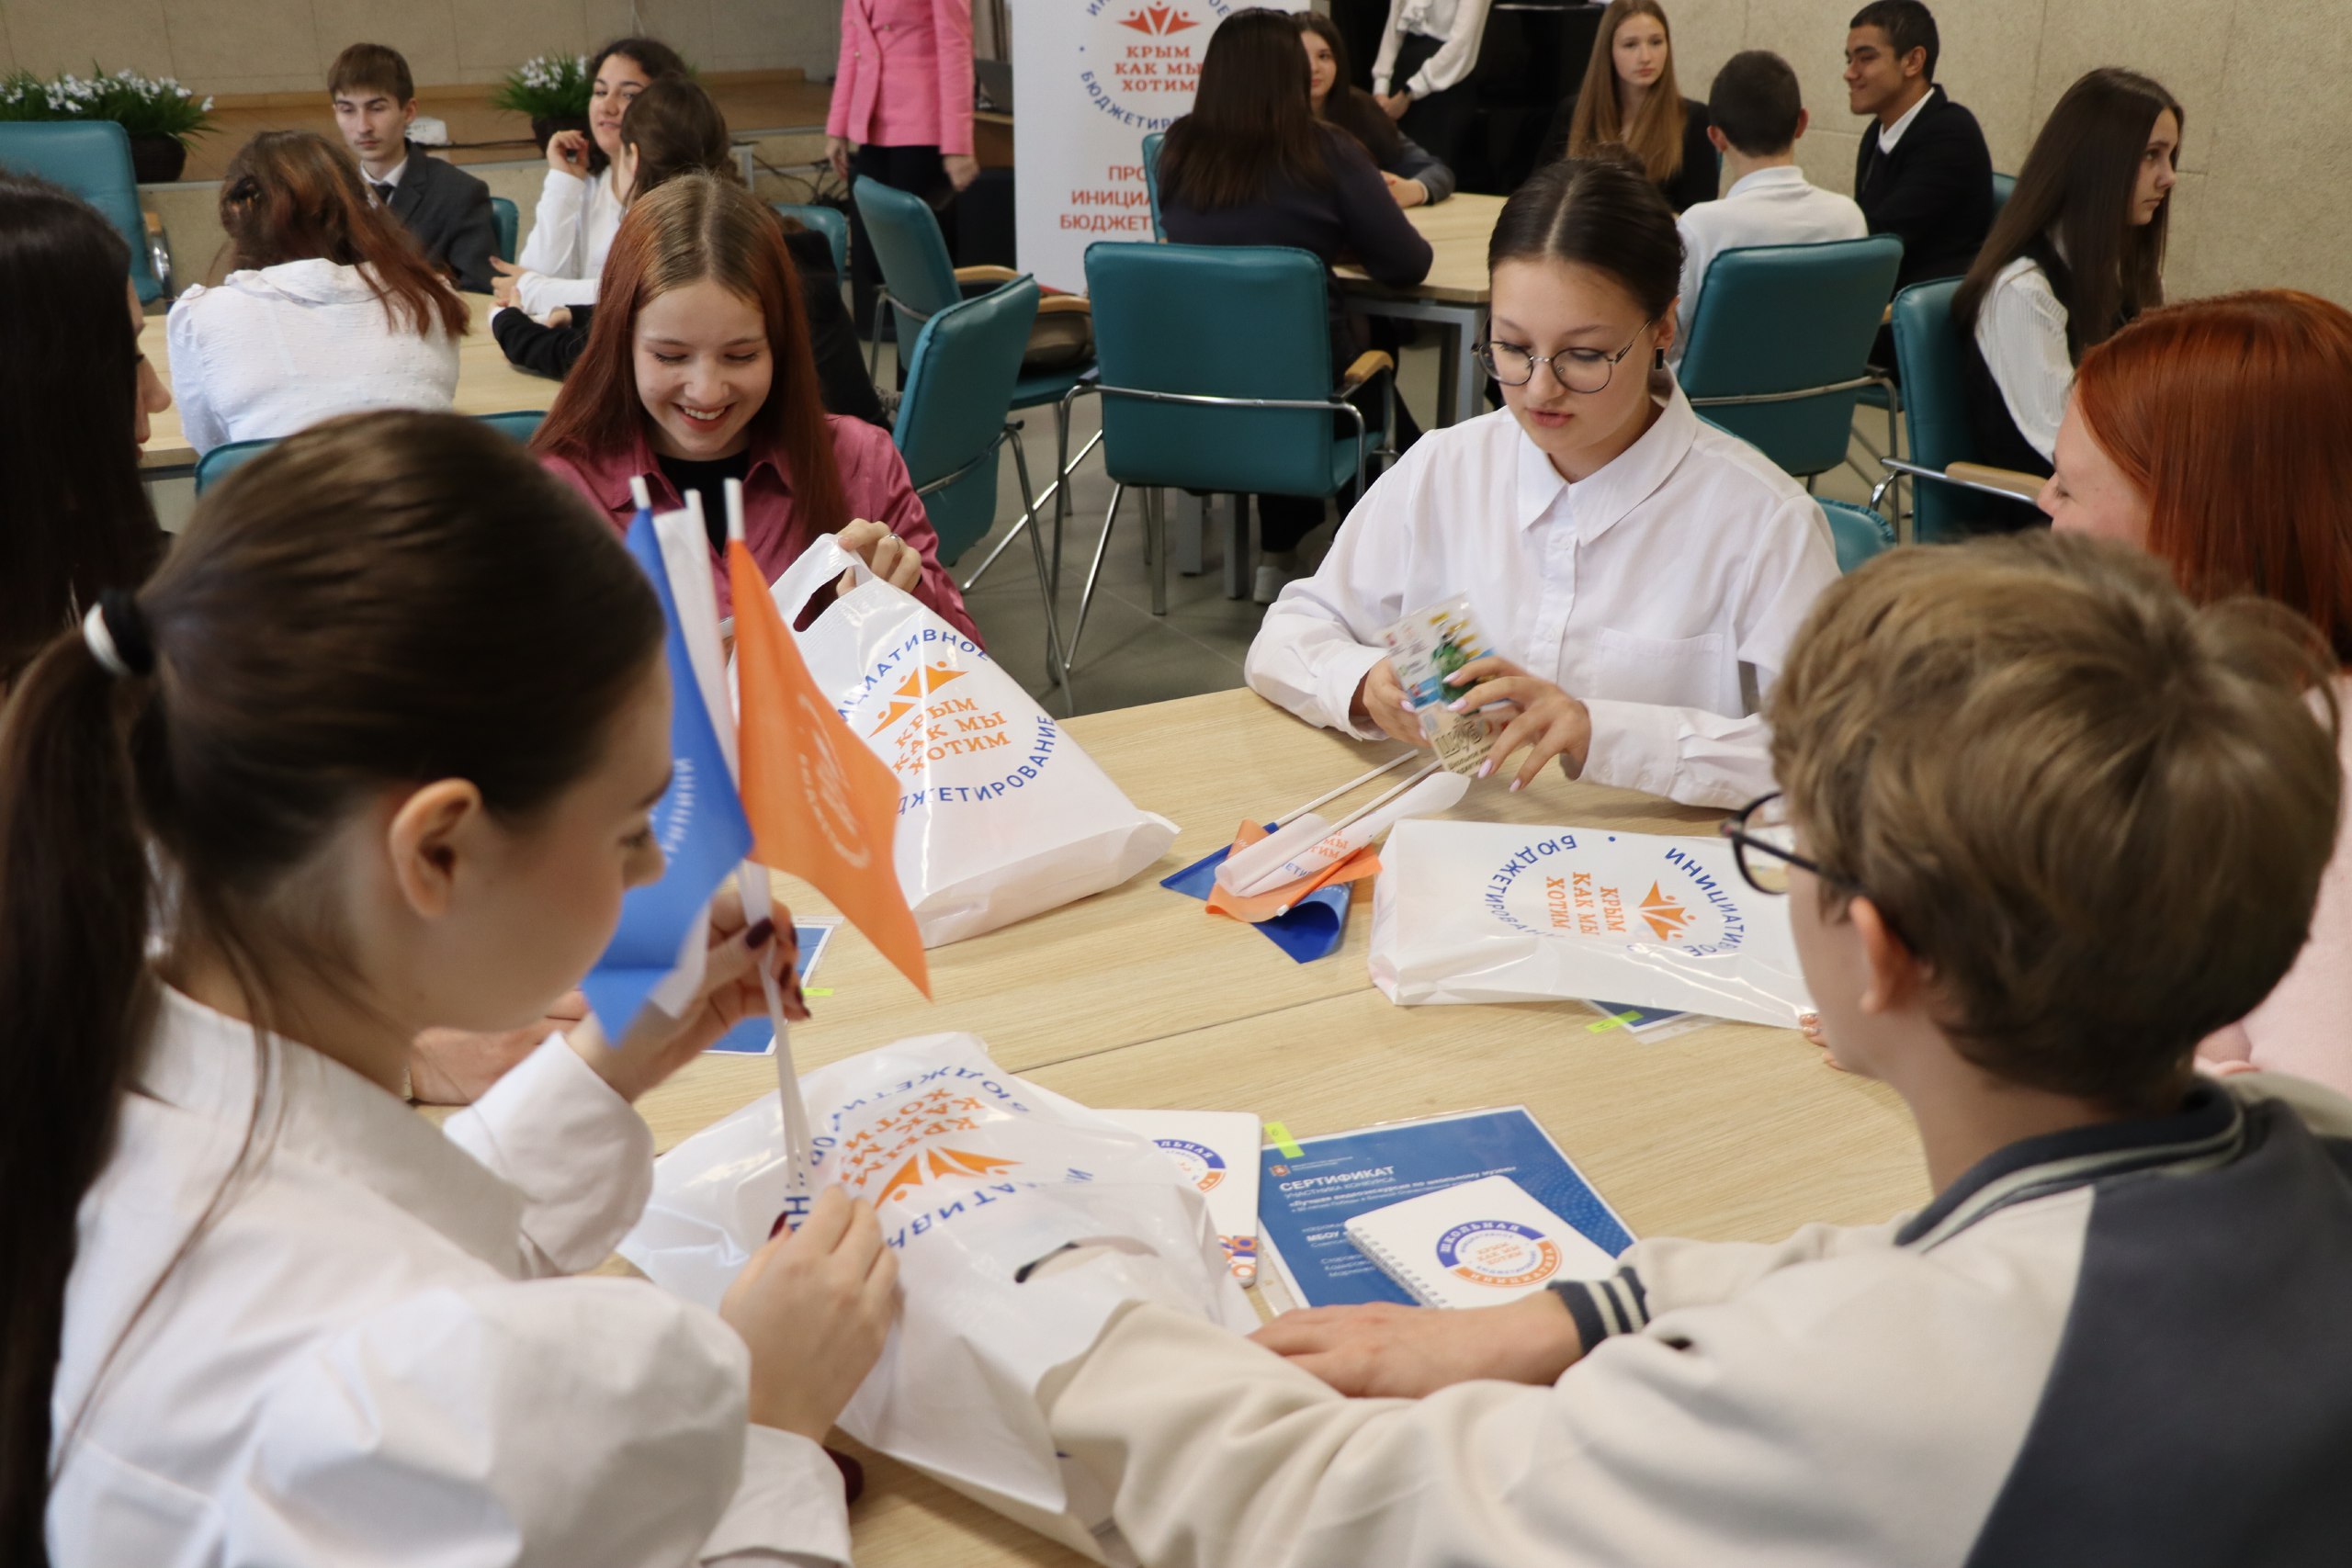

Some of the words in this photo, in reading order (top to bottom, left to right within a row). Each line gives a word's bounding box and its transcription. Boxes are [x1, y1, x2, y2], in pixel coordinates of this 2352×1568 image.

[1126, 46, 1191, 58] КРЫМ
[1114, 62, 1157, 75] КАК
[1167, 62, 1204, 75] МЫ
[1122, 79, 1195, 93] ХОТИМ
[895, 697, 978, 749] КРЫМ
[892, 723, 948, 774] КАК
[956, 710, 1008, 734] МЫ
[908, 730, 1012, 776] ХОТИМ
[1546, 876, 1572, 930] ХОТИМ
[1573, 872, 1594, 908] КАК
[1577, 913, 1600, 936] МЫ
[1600, 886, 1626, 932] КРЫМ
[895, 1097, 985, 1134] КАК
[1279, 1166, 1394, 1191] СЕРТИФИКАТ
[1343, 1177, 1396, 1190] КОНКУРСА
[1306, 1231, 1340, 1242] МБОУ
[1440, 1222, 1521, 1254] ШКОЛЬНАЯ
